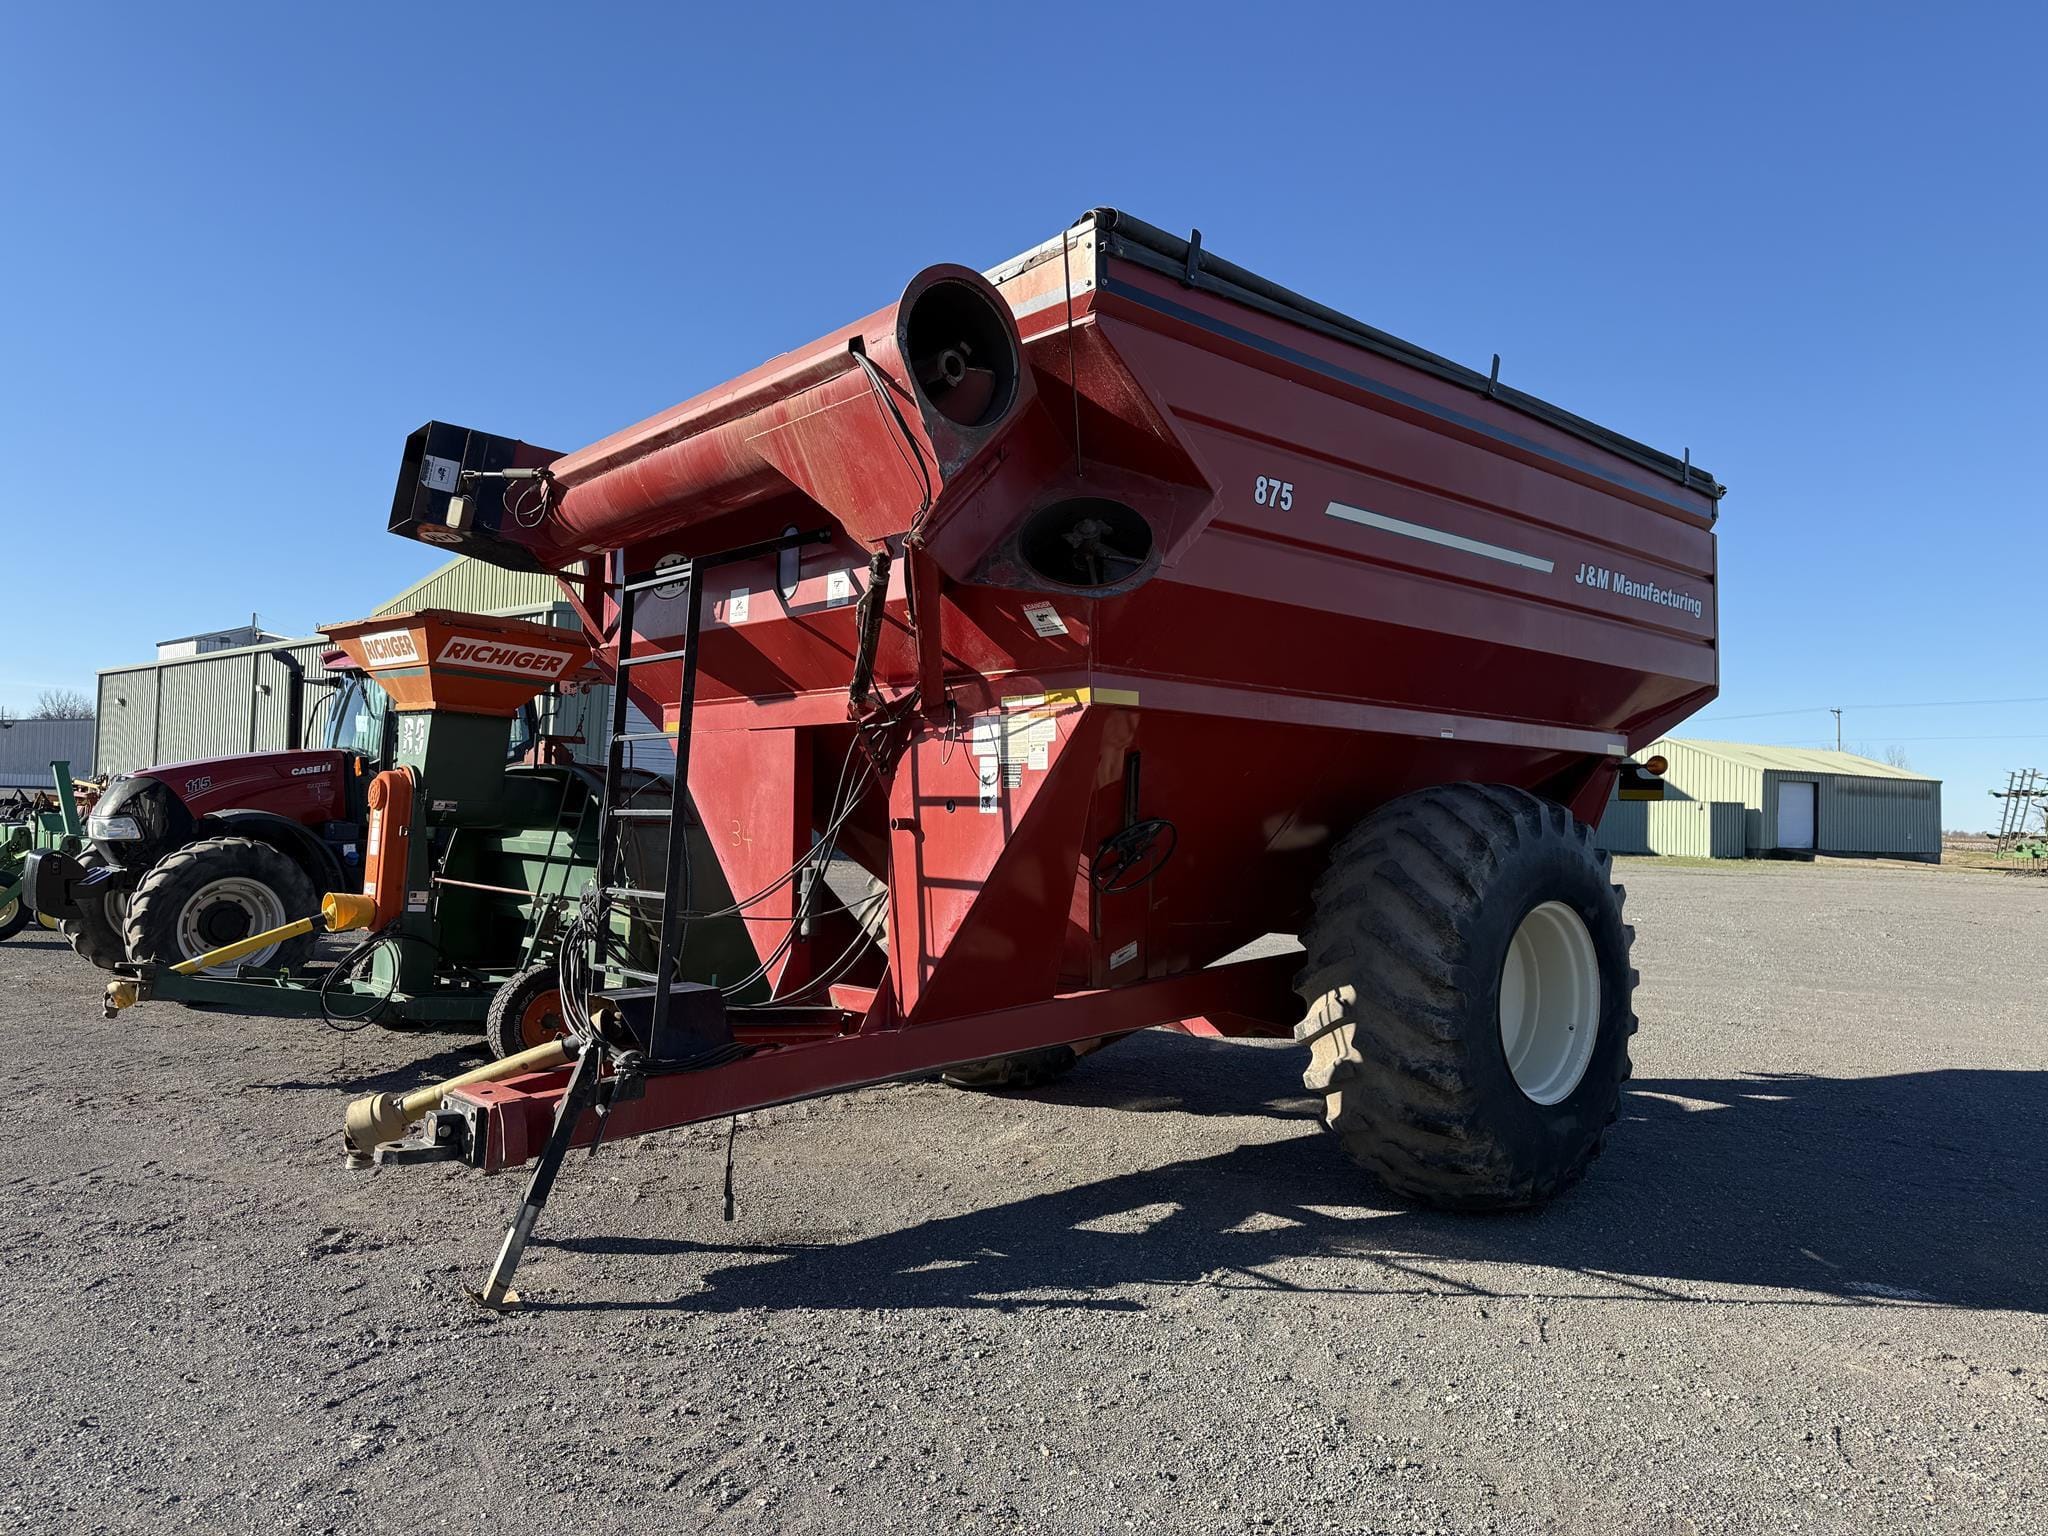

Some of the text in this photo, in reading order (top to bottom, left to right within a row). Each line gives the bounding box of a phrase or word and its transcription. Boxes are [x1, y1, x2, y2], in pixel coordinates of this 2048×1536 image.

[1254, 475, 1293, 511] 875
[1575, 563, 1702, 618] J&M Manufacturing
[364, 634, 415, 661] RICHIGER
[444, 642, 563, 673] RICHIGER
[185, 775, 212, 793] 115
[291, 765, 321, 776] CASE
[732, 819, 753, 854] 34
